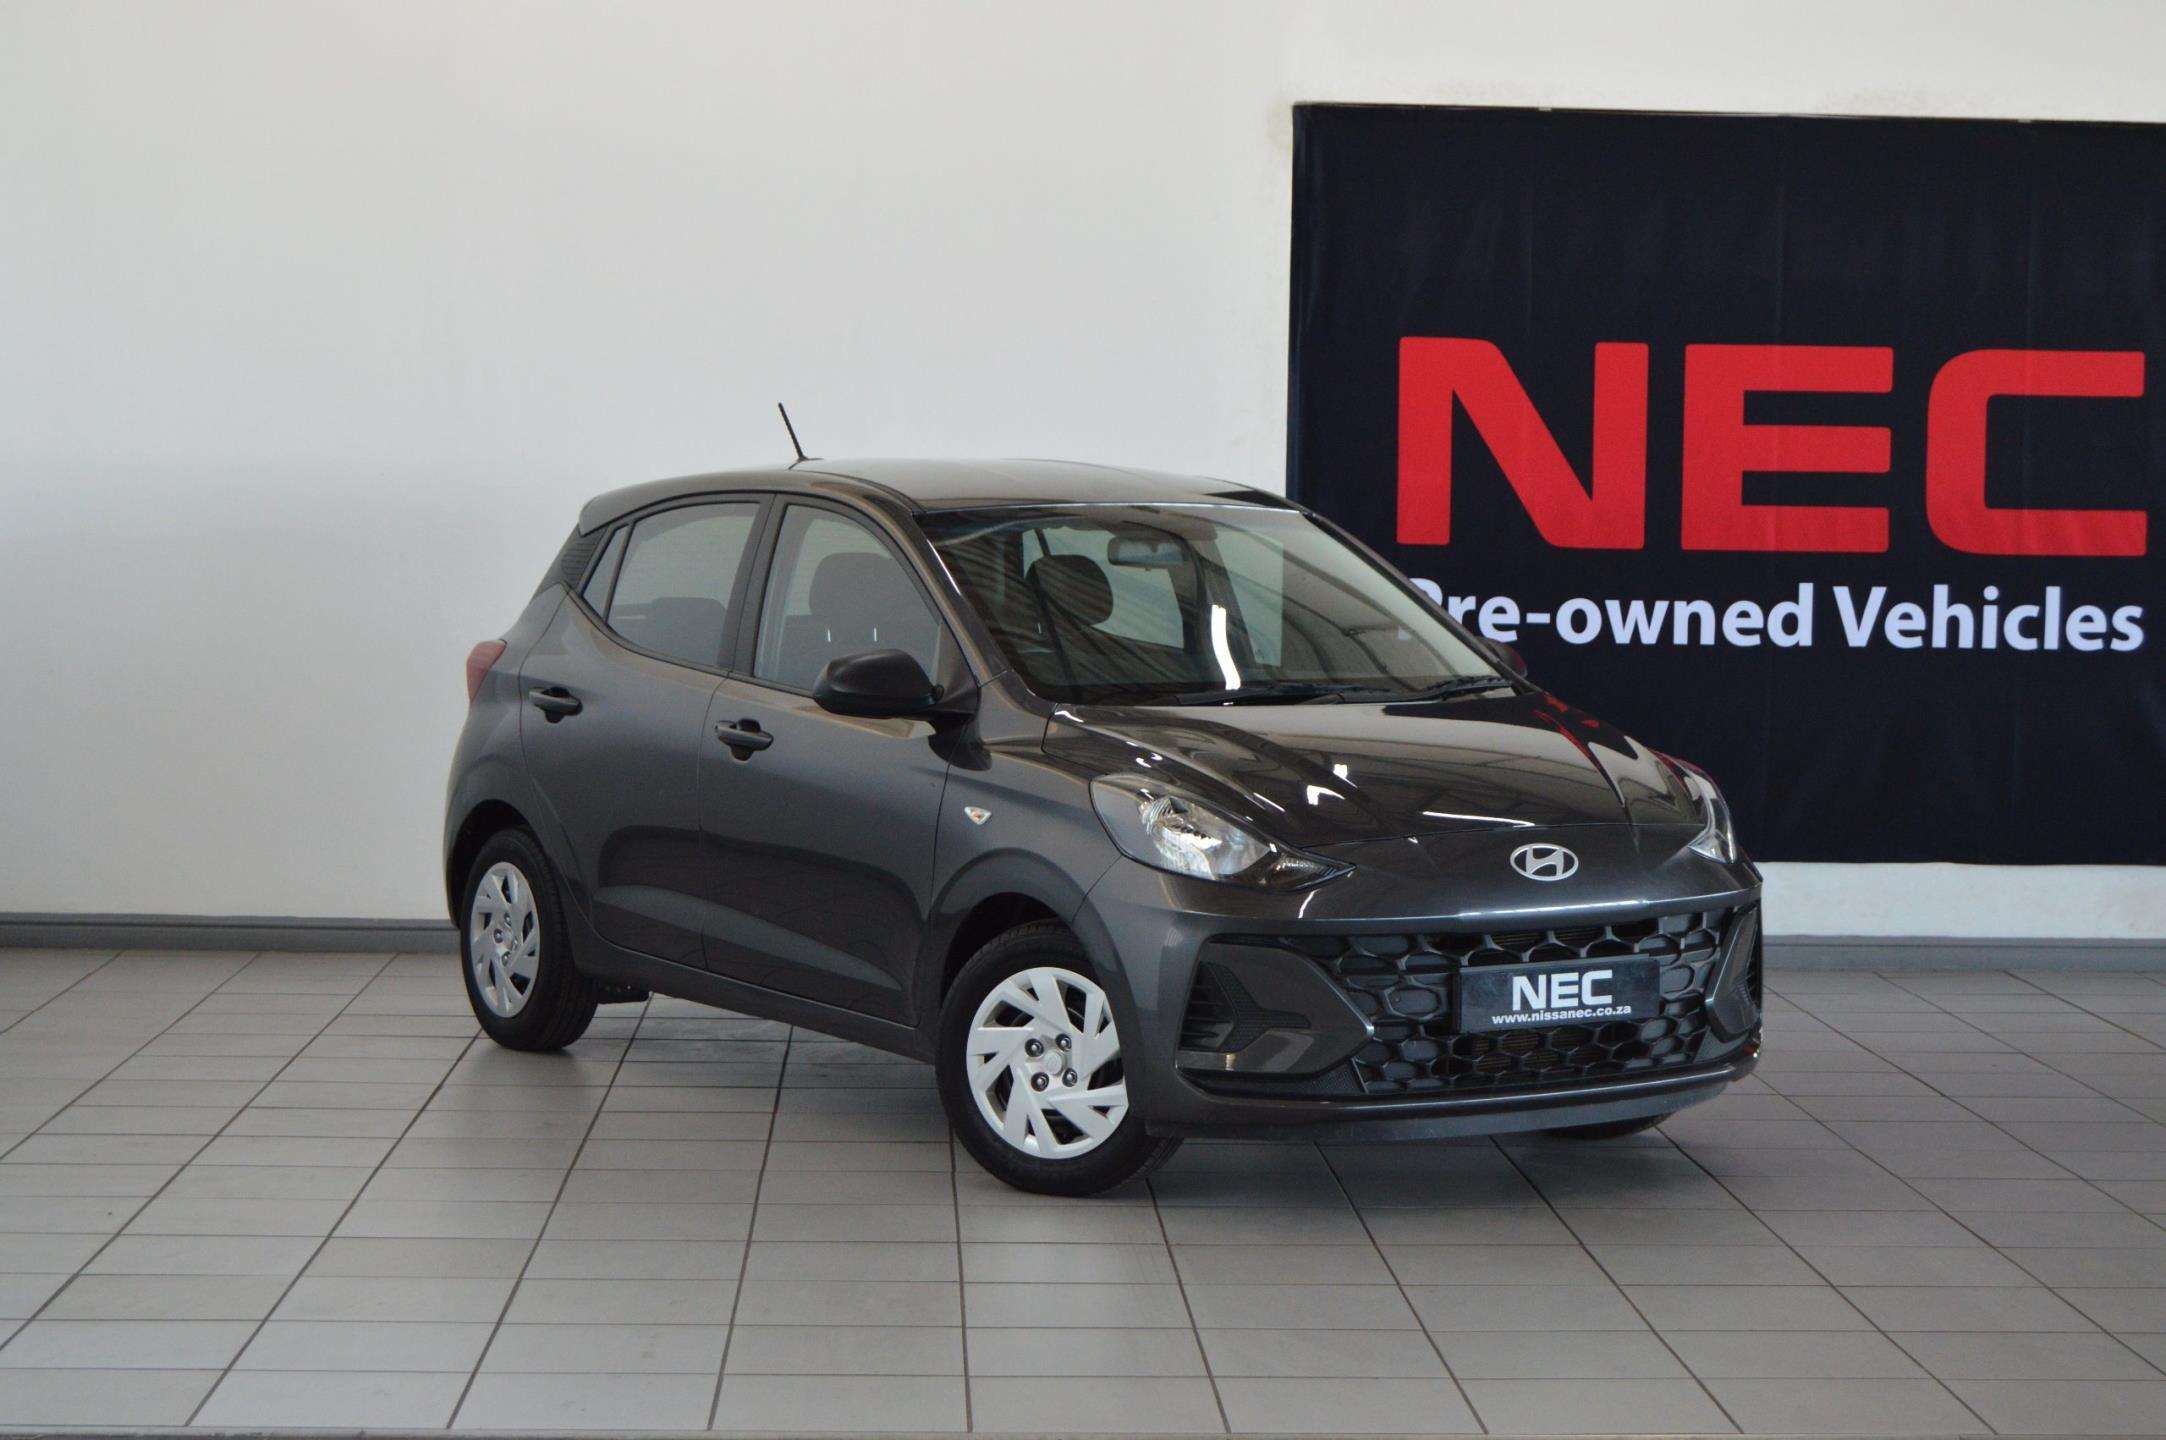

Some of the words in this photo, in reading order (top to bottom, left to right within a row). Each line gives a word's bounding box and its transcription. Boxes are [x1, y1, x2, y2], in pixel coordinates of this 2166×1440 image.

[1397, 336, 2148, 557] NEC
[1834, 585, 2144, 651] Vehicles
[1491, 1004, 1632, 1025] www.nissanec.co.za
[1512, 969, 1613, 1011] NEC
